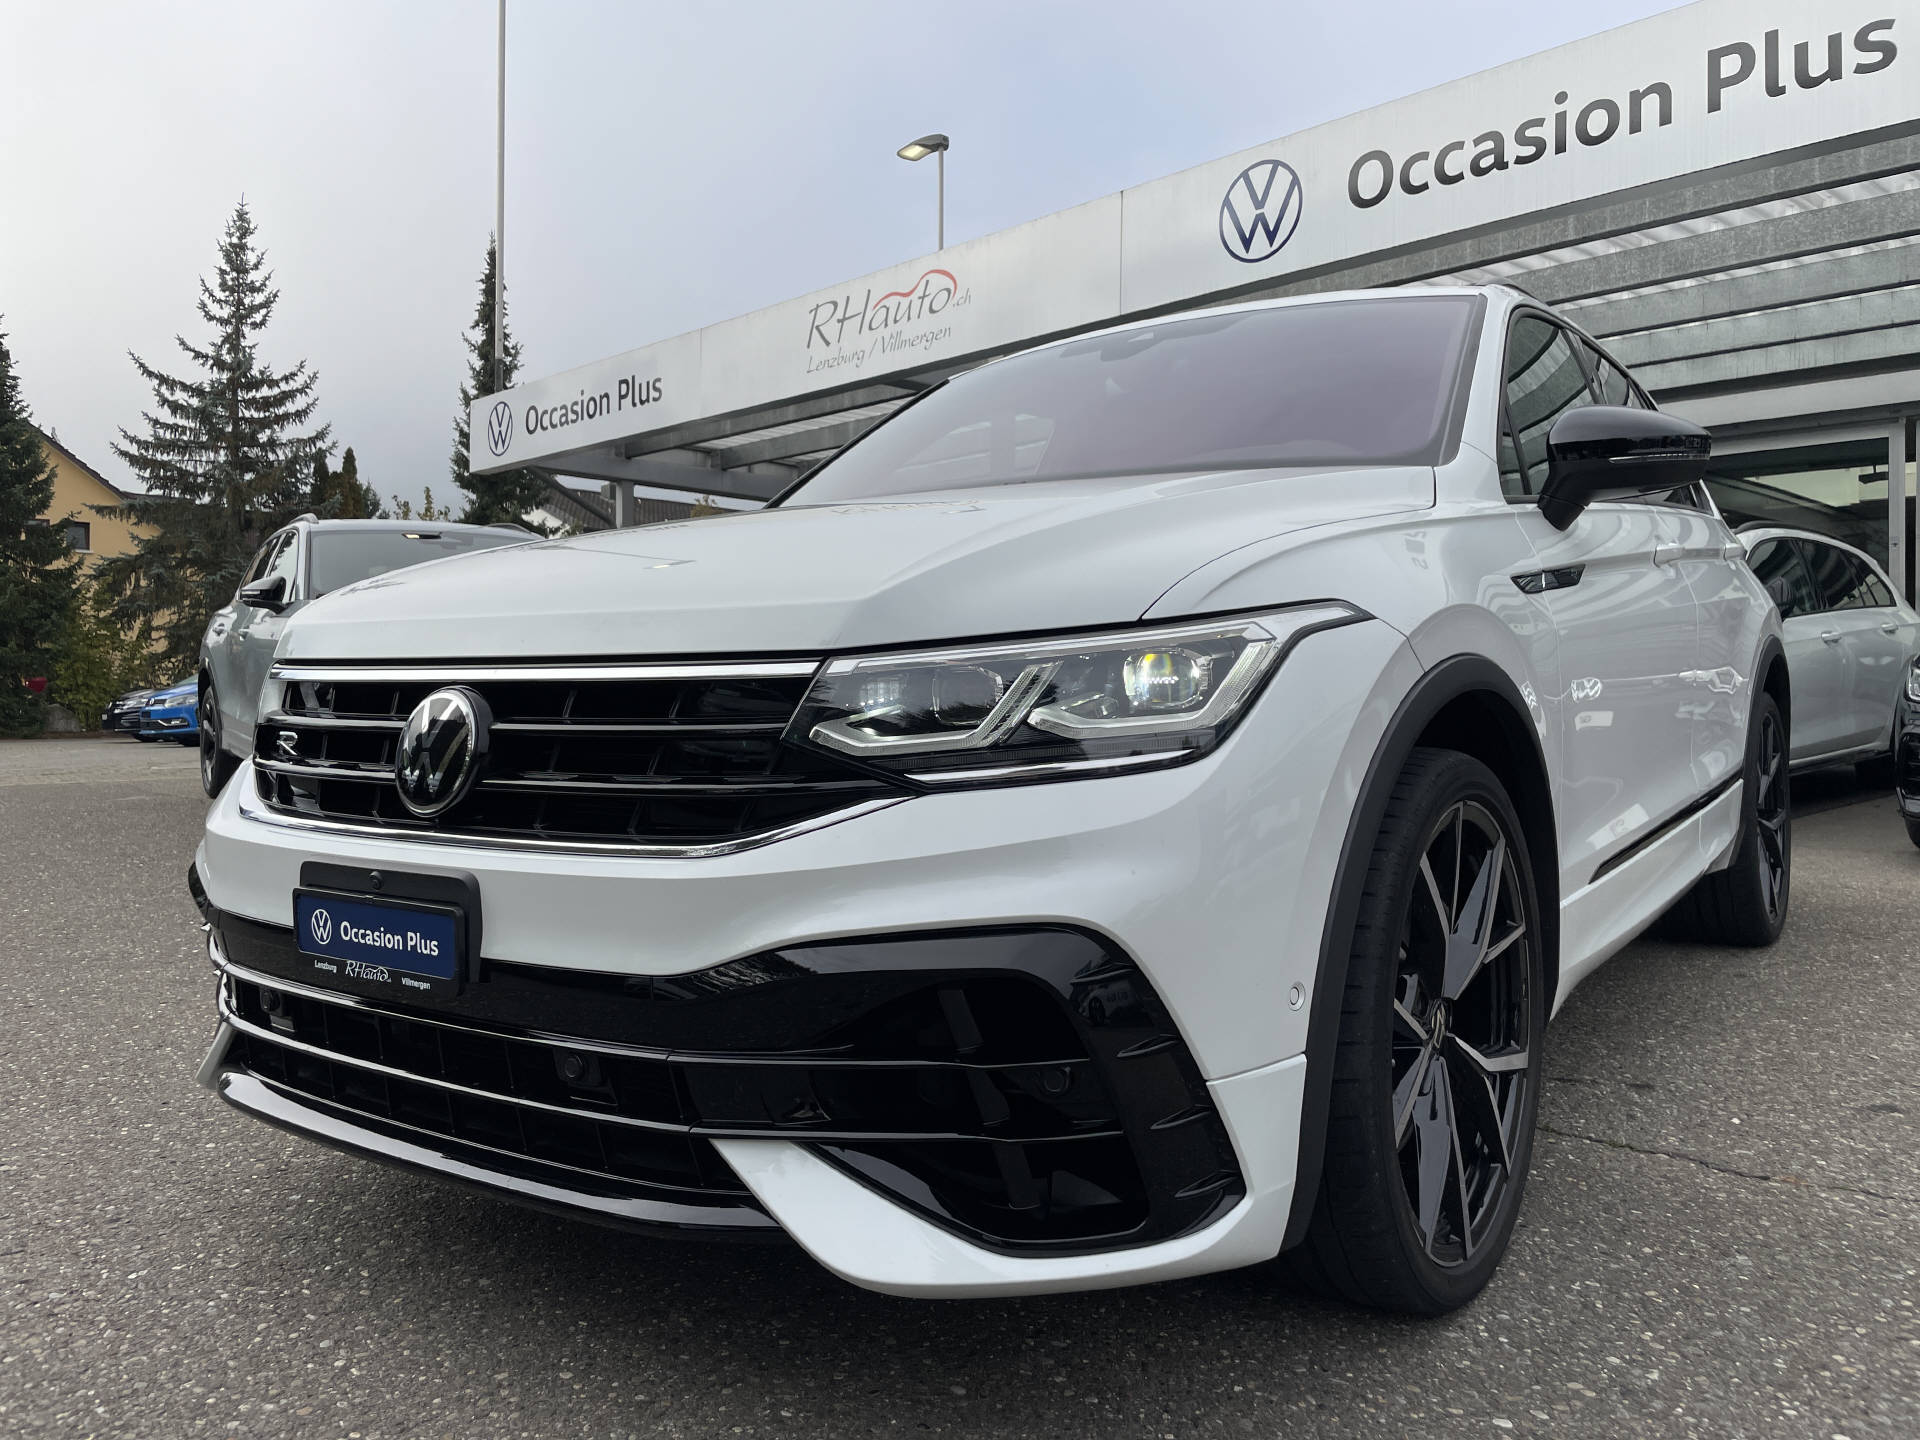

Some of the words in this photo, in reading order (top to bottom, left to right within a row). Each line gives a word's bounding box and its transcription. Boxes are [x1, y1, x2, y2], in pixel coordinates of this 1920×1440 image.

[1347, 91, 1672, 208] Occasion
[1707, 18, 1898, 113] Plus
[807, 347, 865, 373] Lenzburg
[881, 326, 951, 354] Villmergen
[525, 389, 611, 435] Occasion
[618, 375, 662, 411] Plus
[340, 921, 403, 951] Occasion
[407, 931, 439, 956] Plus
[402, 977, 431, 990] Villmergen
